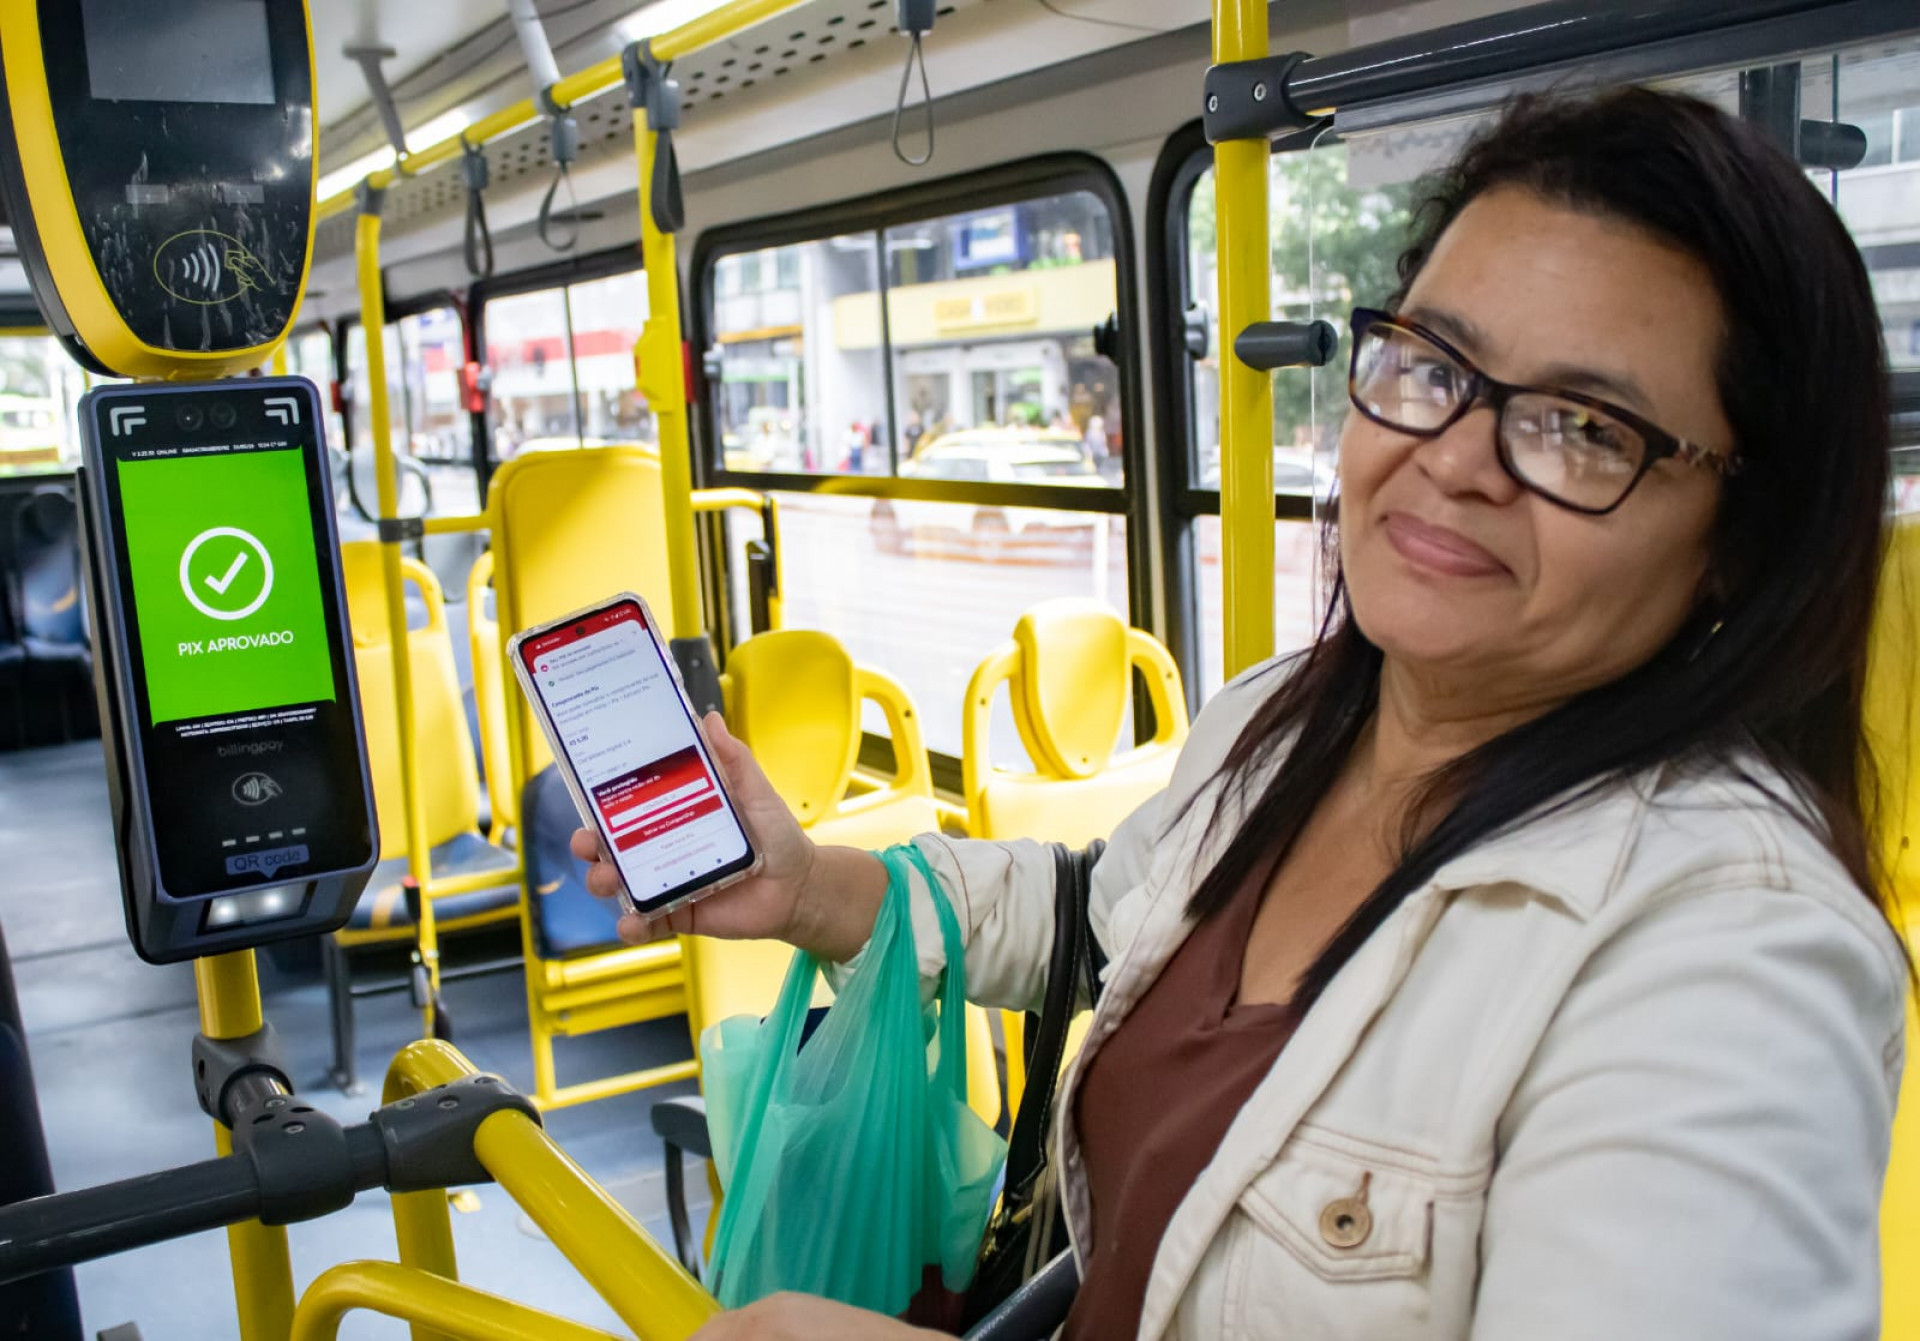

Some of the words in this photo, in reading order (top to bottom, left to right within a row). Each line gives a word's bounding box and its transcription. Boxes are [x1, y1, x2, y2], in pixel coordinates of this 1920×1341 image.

[178, 641, 204, 656] PIX
[207, 630, 294, 653] APROVADO
[217, 740, 283, 757] billingpay
[234, 854, 260, 871] QR
[264, 850, 300, 867] code
